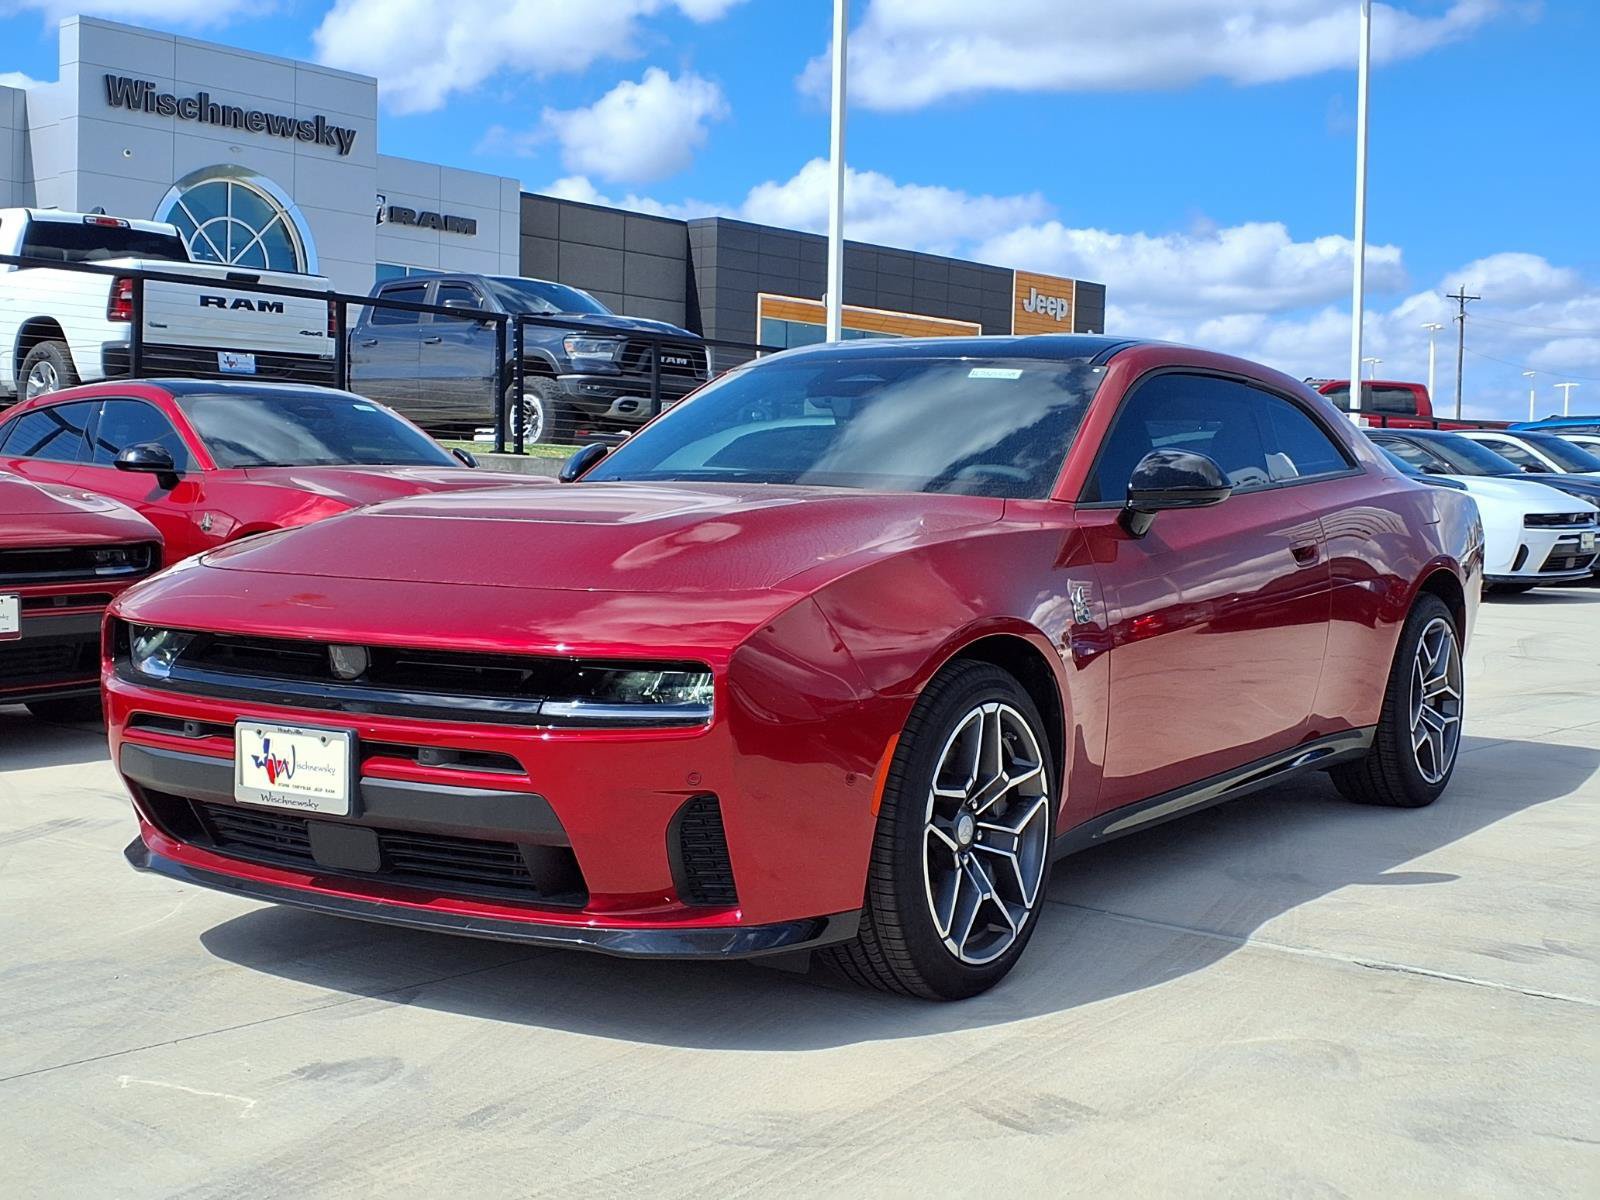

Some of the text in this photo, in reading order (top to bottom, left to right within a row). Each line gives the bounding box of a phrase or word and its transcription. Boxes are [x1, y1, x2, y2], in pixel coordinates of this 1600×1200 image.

[105, 74, 357, 155] Wischnewsky
[388, 205, 477, 235] RAM
[200, 295, 284, 314] RAM
[1023, 287, 1068, 321] Jeep
[260, 791, 319, 810] Wischnewsky
